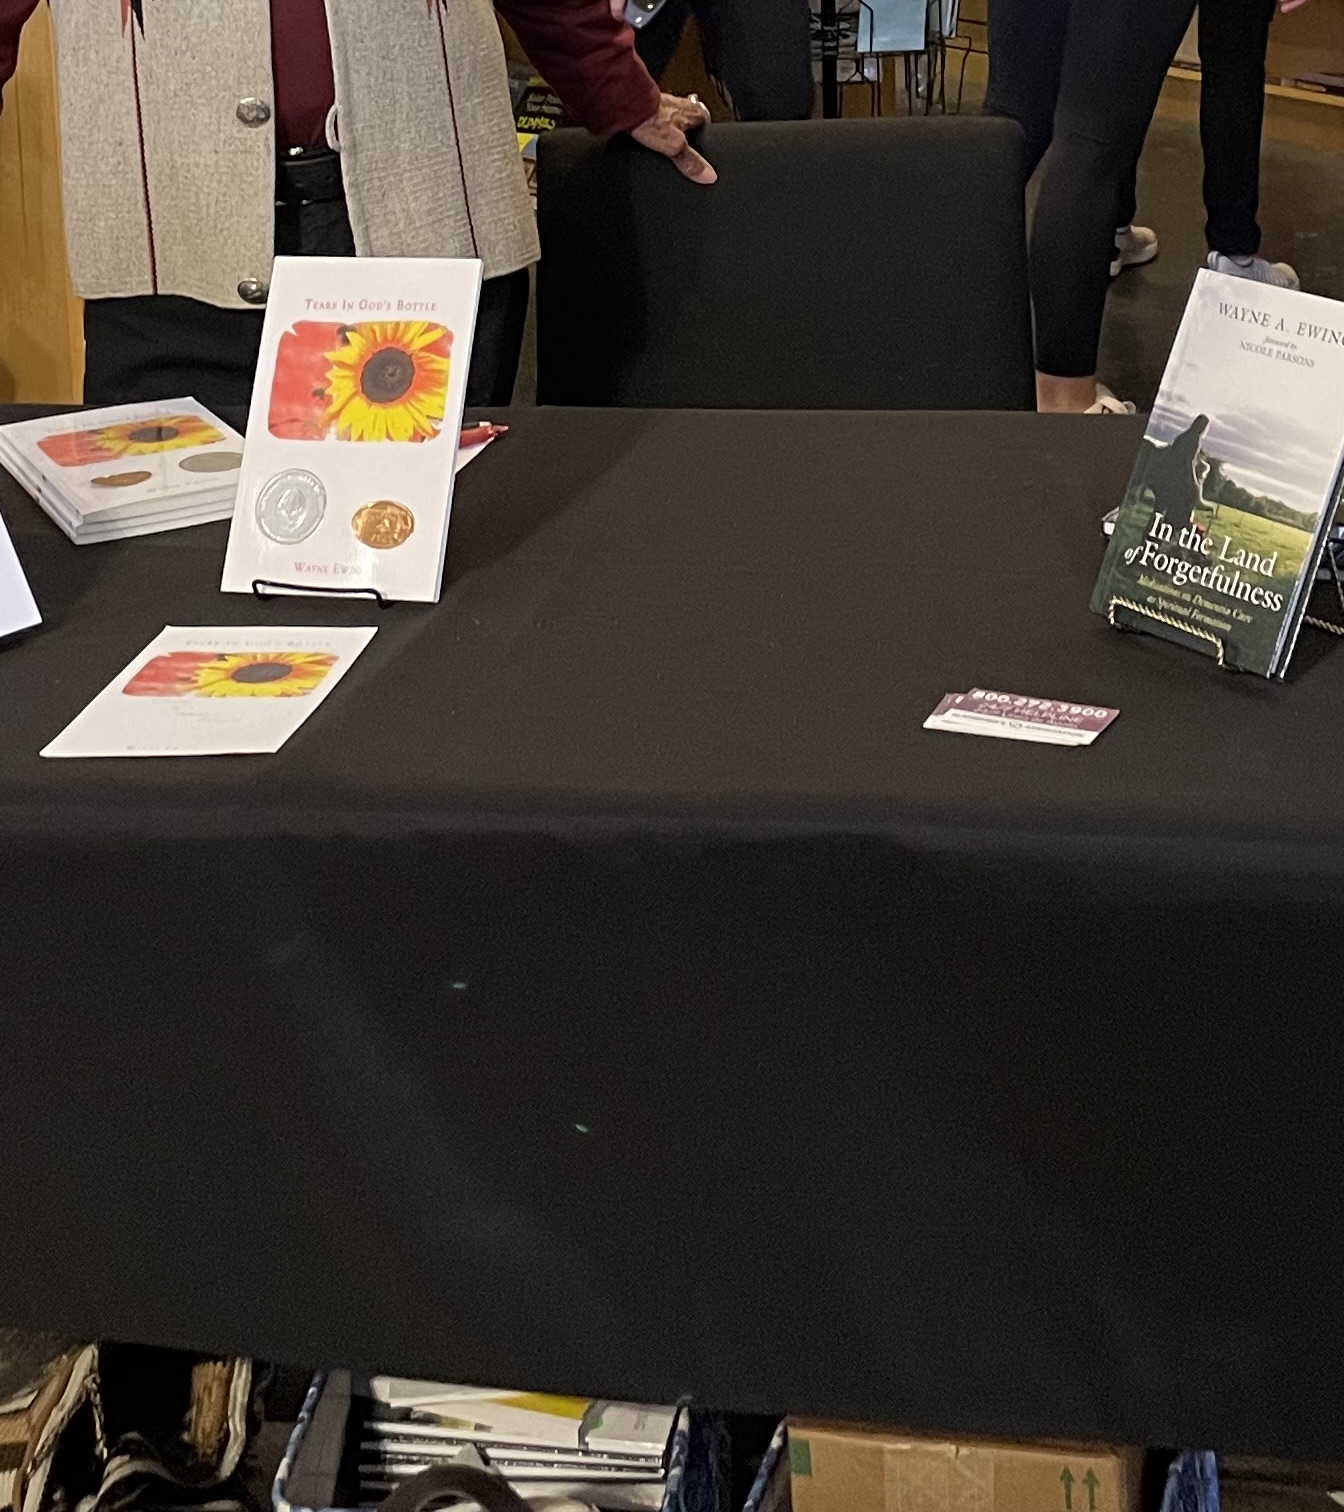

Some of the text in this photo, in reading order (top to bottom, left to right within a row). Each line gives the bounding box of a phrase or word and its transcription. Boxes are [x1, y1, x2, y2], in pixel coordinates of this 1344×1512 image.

[305, 299, 337, 310] TEARS
[342, 299, 355, 310] IN
[397, 300, 437, 311] BOTTLE
[1219, 302, 1271, 327] WAYNE
[1274, 318, 1290, 333] A.
[1239, 340, 1316, 368] NICOLE PARSONS
[1148, 511, 1278, 578] In the Land
[1124, 539, 1284, 612] of Forgetfulness
